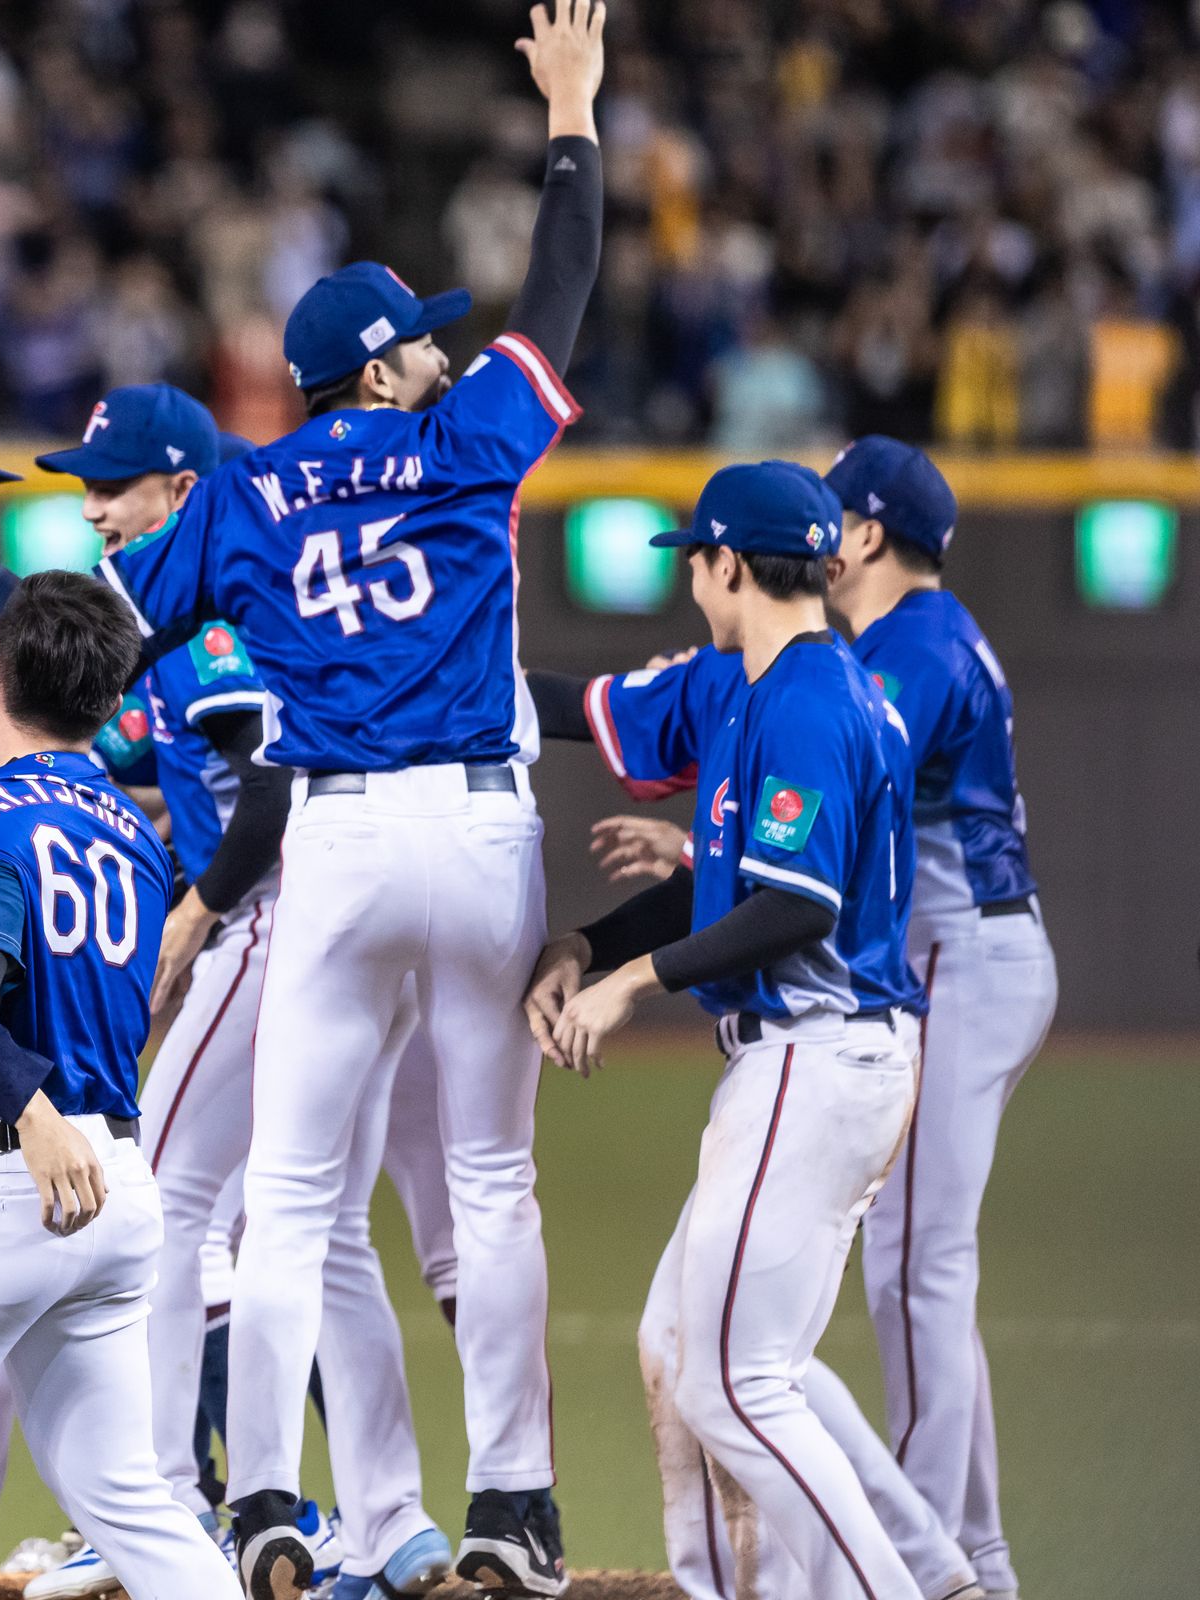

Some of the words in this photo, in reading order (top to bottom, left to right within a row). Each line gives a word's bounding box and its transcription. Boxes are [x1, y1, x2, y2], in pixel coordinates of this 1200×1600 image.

[250, 454, 424, 525] W.E.LIN
[292, 511, 435, 637] 45
[30, 823, 139, 968] 60
